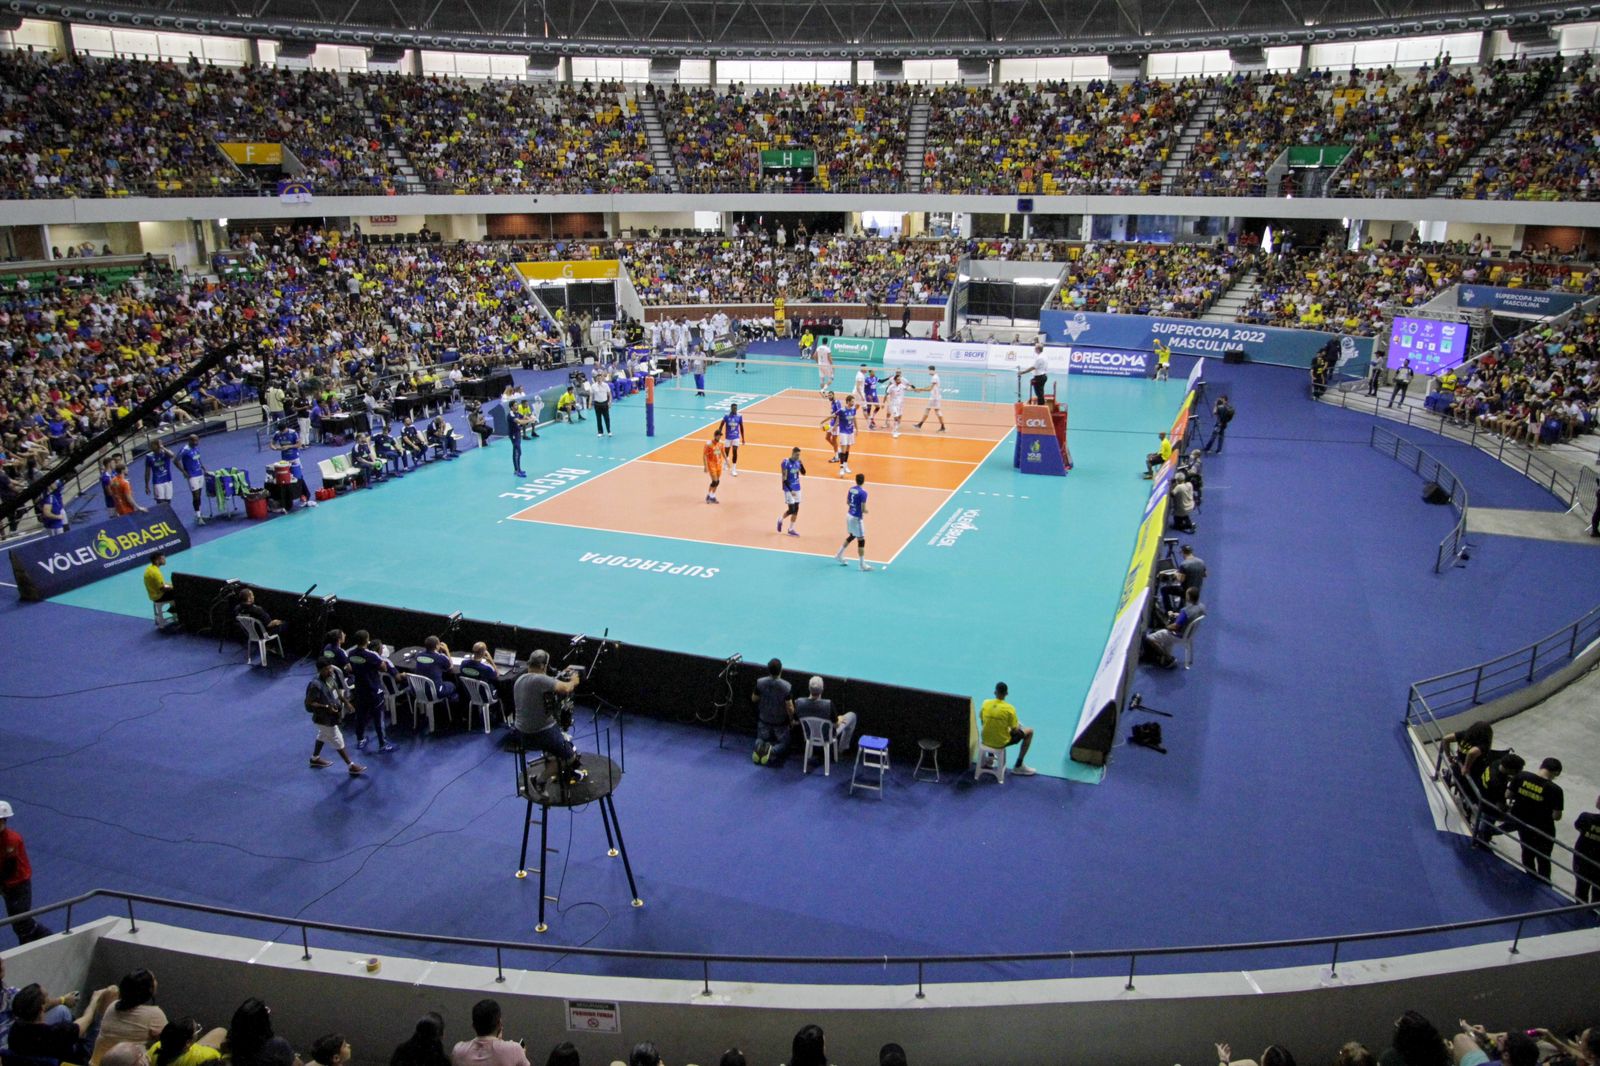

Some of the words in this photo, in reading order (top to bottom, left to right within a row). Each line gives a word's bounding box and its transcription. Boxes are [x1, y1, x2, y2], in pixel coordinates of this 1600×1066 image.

[246, 146, 255, 162] F
[783, 152, 793, 166] H
[562, 264, 574, 278] G
[1495, 292, 1533, 302] SUPERCOPA
[1532, 296, 1550, 304] 2022
[1502, 300, 1540, 308] MASCULINA
[1151, 322, 1230, 340] SUPERCOPA
[1231, 330, 1266, 343] 2022
[834, 343, 859, 351] Unimed
[1167, 337, 1245, 352] MASCULINA
[964, 351, 985, 359] RECIFE
[1082, 352, 1145, 366] RECOMA
[1026, 419, 1047, 427] GOL
[498, 467, 592, 501] RECIFE
[38, 545, 98, 575] VÔLEI
[116, 521, 177, 551] BRASIL
[578, 551, 720, 579] SUPERCOPA
